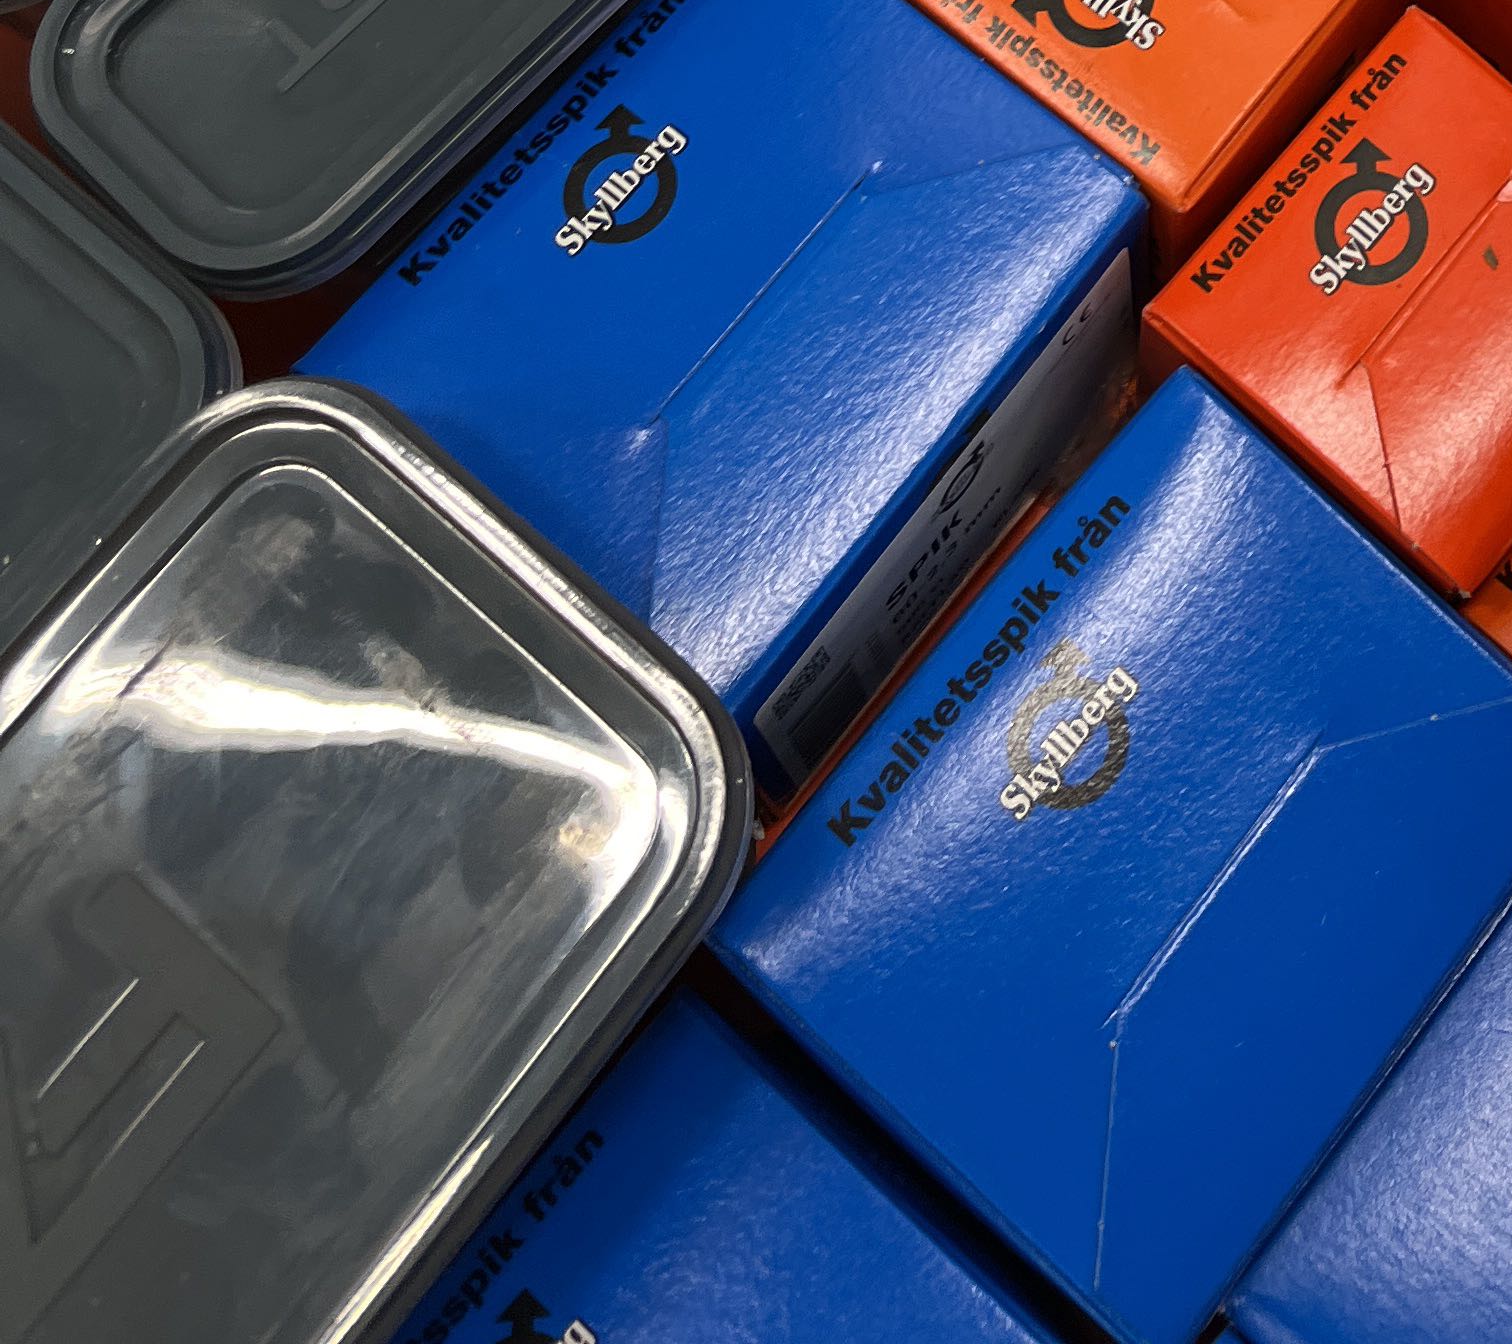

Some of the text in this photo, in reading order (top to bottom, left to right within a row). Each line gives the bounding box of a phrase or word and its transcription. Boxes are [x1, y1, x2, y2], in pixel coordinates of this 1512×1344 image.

[984, 18, 1161, 167] Kvalitetsspik
[398, 53, 621, 287] Kvalitetsspik
[554, 124, 688, 258] Skyllberg
[1191, 51, 1408, 293] Kvalitetsspik från
[1309, 162, 1436, 295] Skyllberg
[886, 511, 963, 611] SPIK
[827, 576, 1059, 847] Kvalitetsspik
[1052, 495, 1131, 579] från
[1001, 666, 1138, 820] Skyllberg
